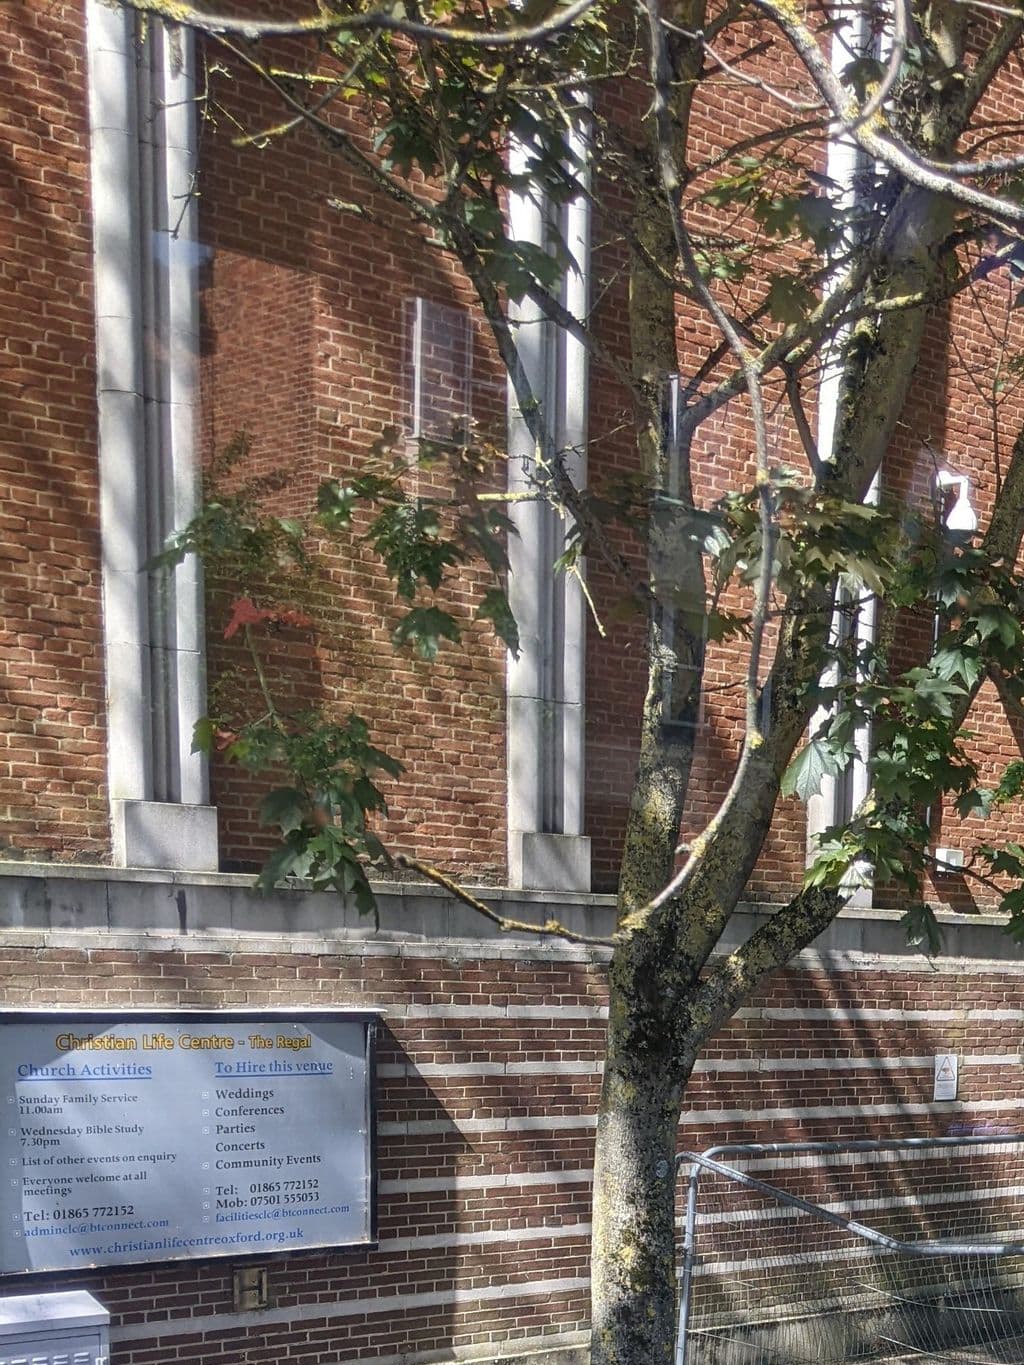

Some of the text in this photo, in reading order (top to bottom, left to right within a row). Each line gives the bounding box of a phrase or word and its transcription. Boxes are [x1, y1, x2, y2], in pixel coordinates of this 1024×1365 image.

[56, 1034, 137, 1050] Christian
[143, 1034, 174, 1050] Life
[178, 1034, 235, 1050] Centre
[250, 1035, 273, 1049] The
[276, 1034, 312, 1051] Regal
[18, 1062, 152, 1077] Church Activities
[215, 1060, 333, 1074] To Hire this venue
[19, 1094, 138, 1106] Sunday Family Service
[216, 1088, 274, 1101] Weddings
[19, 1106, 63, 1115] 11.00am
[216, 1105, 285, 1117] Conferences
[21, 1124, 144, 1138] Wednesday Bible Study
[216, 1124, 256, 1135] Parties
[21, 1138, 60, 1148] 7.30pm
[216, 1141, 266, 1152] Concerts
[22, 1152, 177, 1166] List of other events on enquiry
[216, 1154, 321, 1170] Community Events
[23, 1171, 147, 1188] Everyone welcome at all
[24, 1186, 72, 1197] meetings
[216, 1179, 319, 1196] Tel: 01865 772152
[216, 1192, 320, 1210] Mob: 07501 555053
[24, 1205, 134, 1222] Tel: 01865 772152
[70, 1228, 304, 1256] www.christianlifecentreoxford.org.uk
